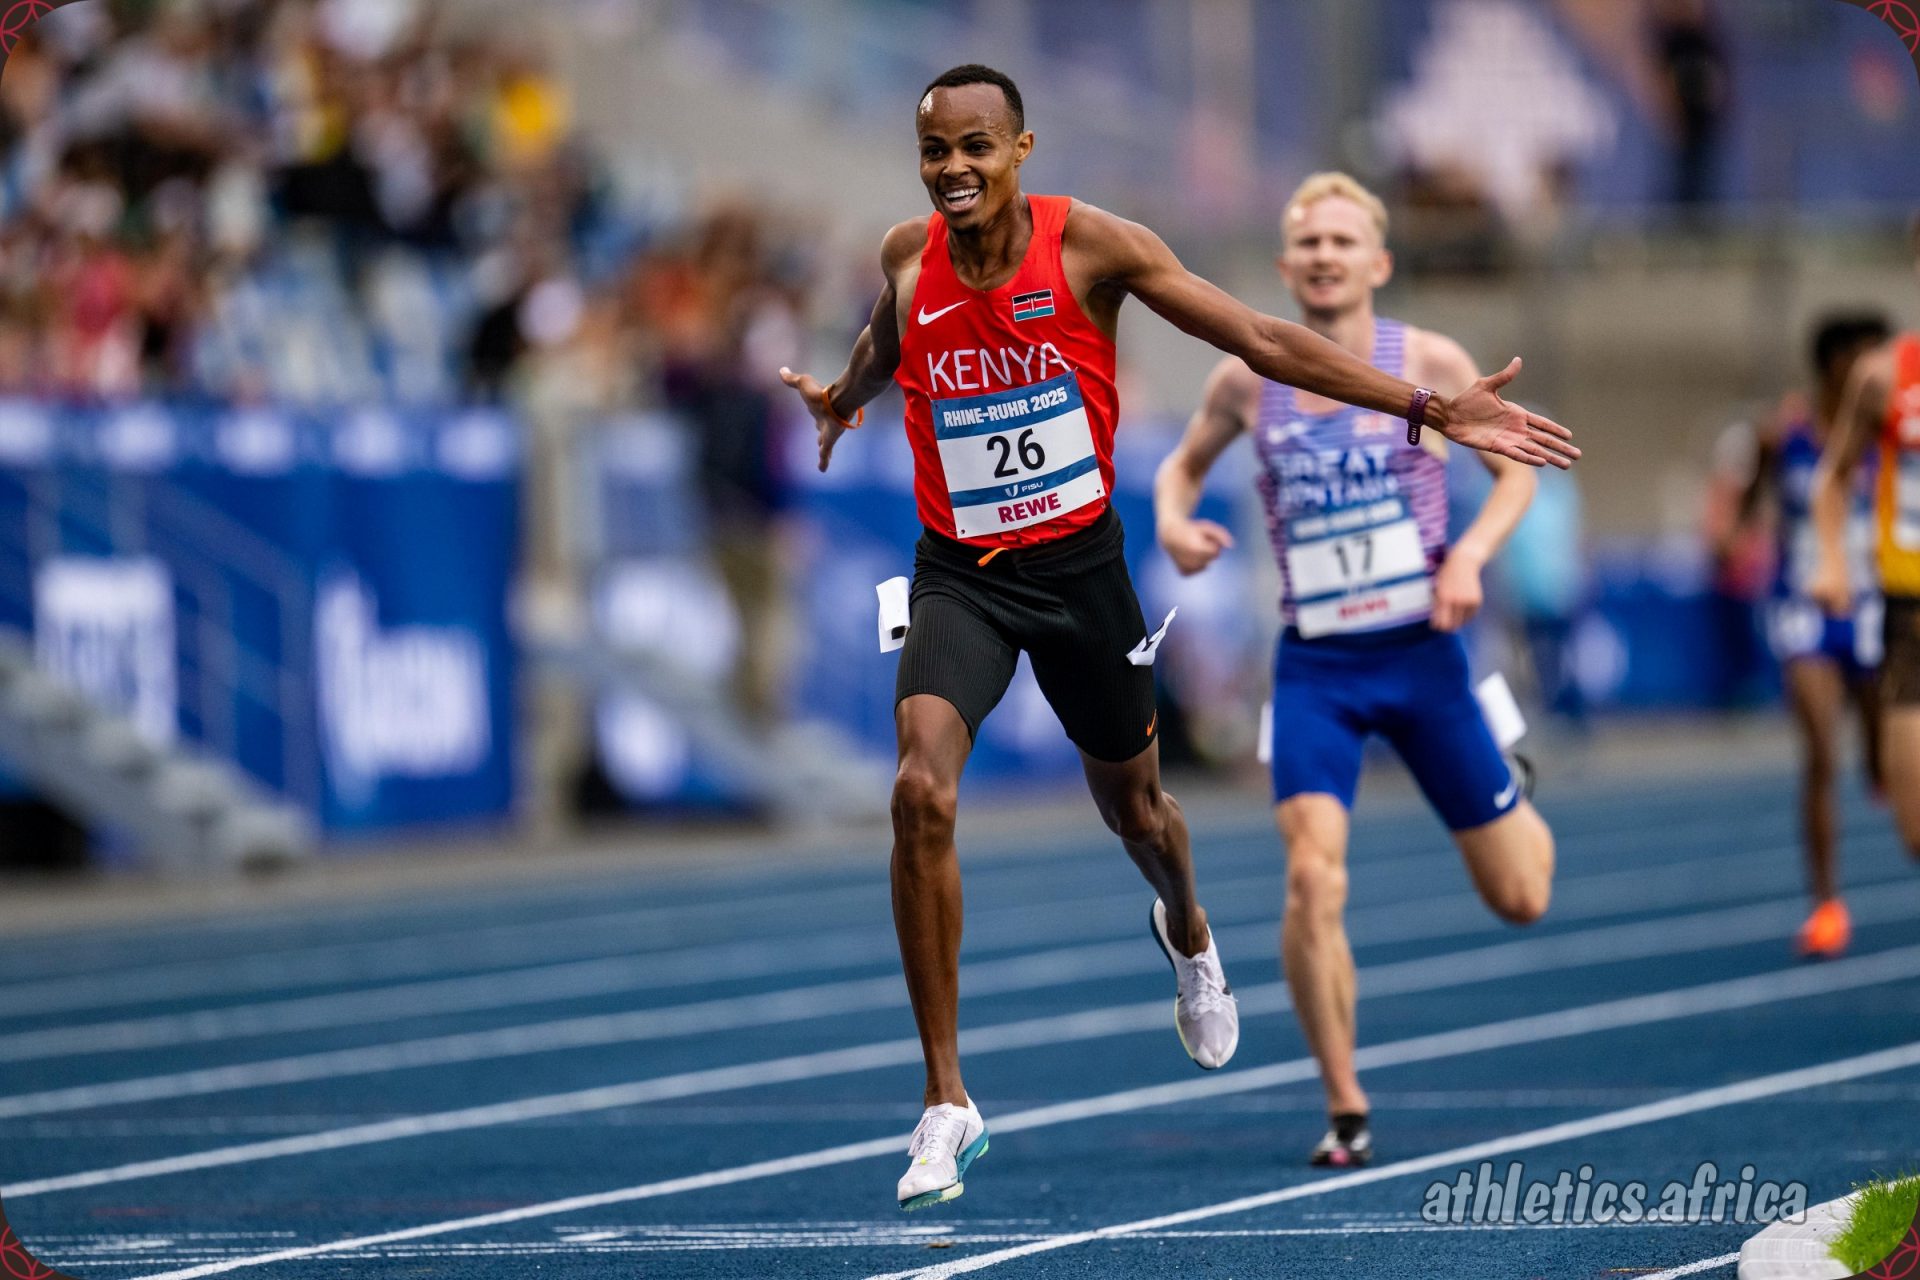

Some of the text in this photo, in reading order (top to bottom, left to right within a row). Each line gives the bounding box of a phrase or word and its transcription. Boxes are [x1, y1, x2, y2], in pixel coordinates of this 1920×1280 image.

[927, 341, 1072, 392] KENYA
[943, 387, 1068, 427] RHINE-RUHR 2025
[986, 428, 1046, 478] 26
[1021, 481, 1044, 492] FISU
[998, 492, 1061, 524] REWE
[1335, 533, 1374, 576] 17
